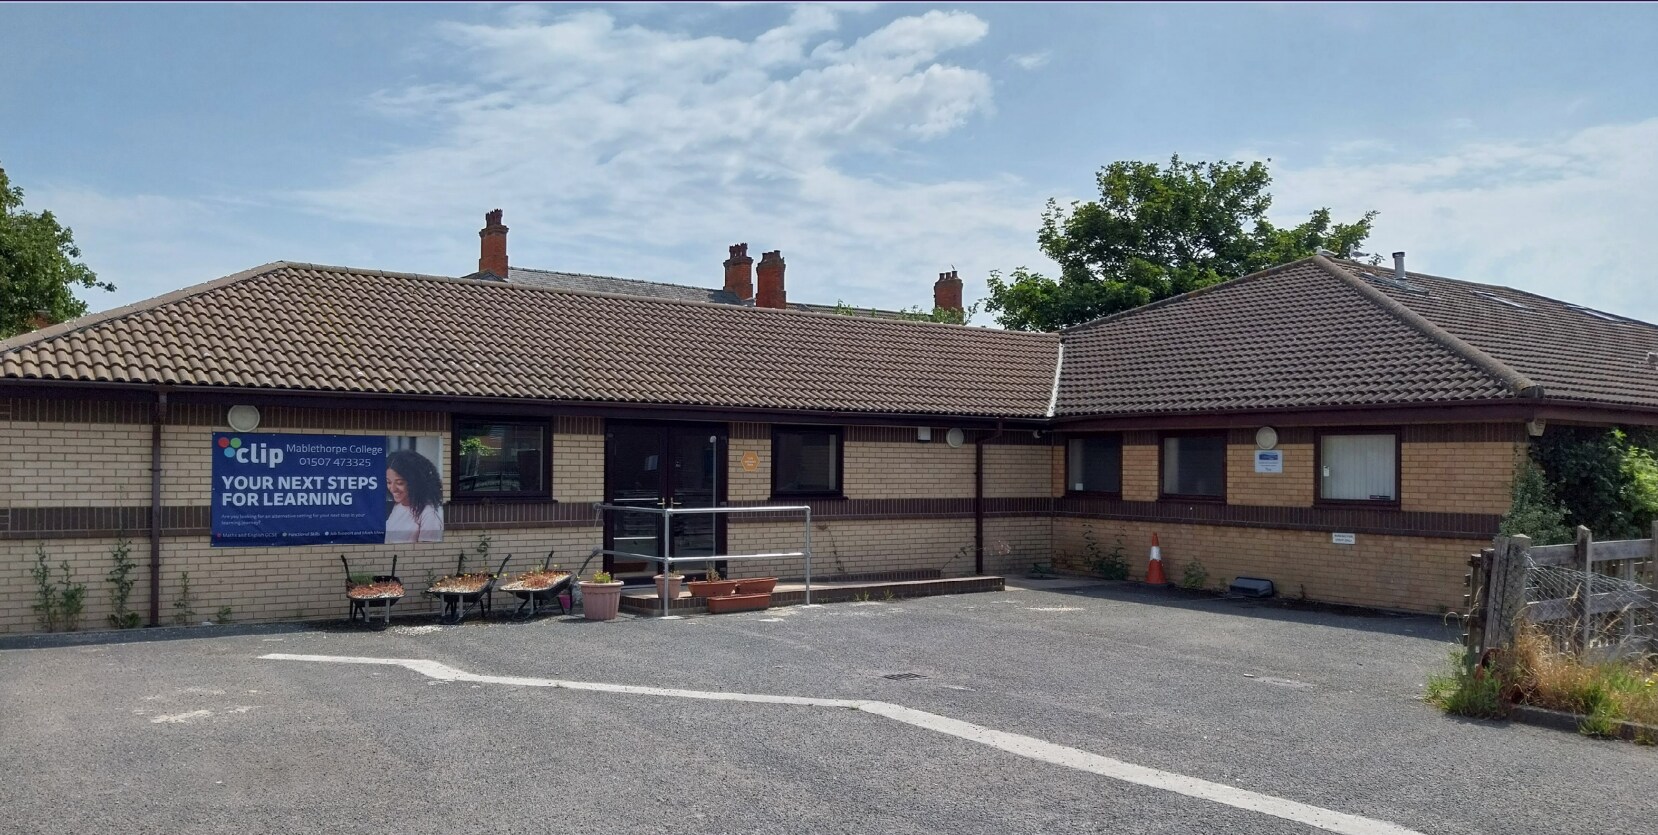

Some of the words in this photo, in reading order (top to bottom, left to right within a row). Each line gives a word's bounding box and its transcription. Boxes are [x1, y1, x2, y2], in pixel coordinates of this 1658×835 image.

[236, 443, 284, 468] clip
[286, 444, 347, 454] Mablethorpe
[350, 445, 382, 456] College
[300, 457, 330, 466] 01507
[333, 458, 371, 467] 473325
[222, 476, 274, 490] YOUR
[278, 476, 324, 490] NEXT
[328, 476, 378, 489] STEPS
[222, 492, 259, 506] FOR
[264, 492, 353, 506] LEARNING
